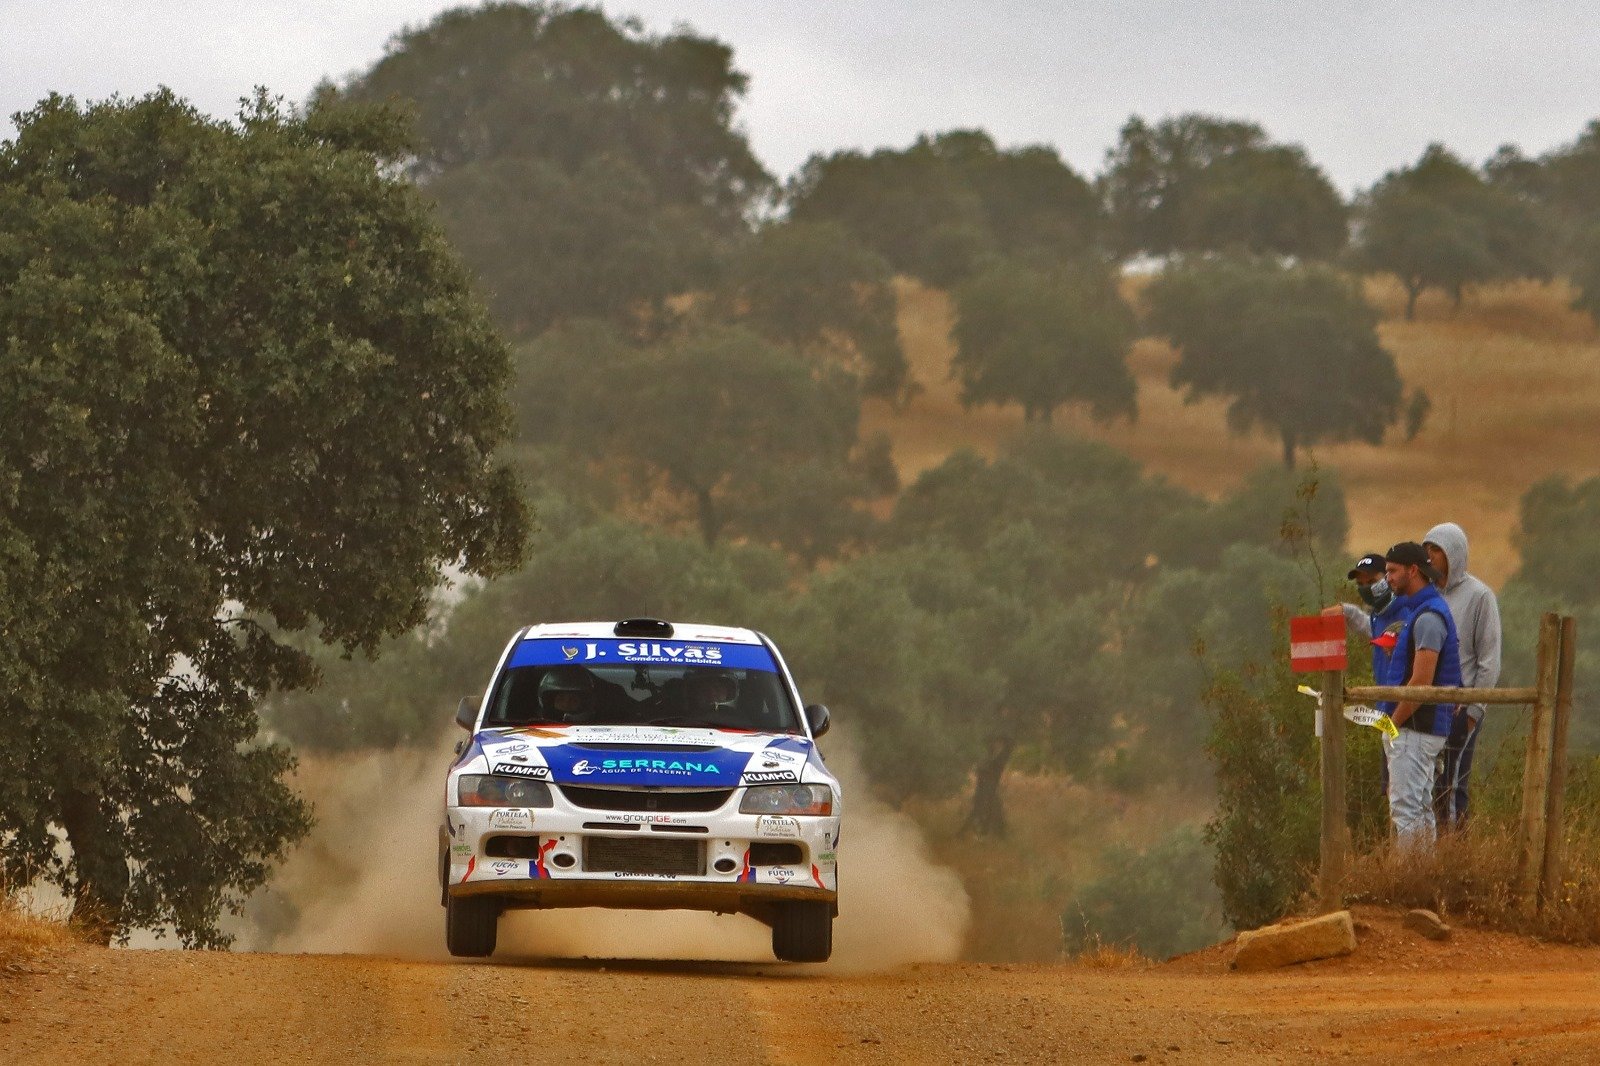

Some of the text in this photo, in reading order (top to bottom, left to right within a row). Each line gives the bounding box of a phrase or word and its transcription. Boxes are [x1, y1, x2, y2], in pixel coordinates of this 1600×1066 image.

[585, 642, 723, 660] J. Silvas
[494, 764, 549, 777] KUMHO
[602, 759, 721, 775] SERRANA
[646, 768, 692, 776] NASCENTE
[744, 772, 796, 782] KUMHO
[491, 861, 520, 869] FUCHS
[768, 869, 795, 877] FUCHS
